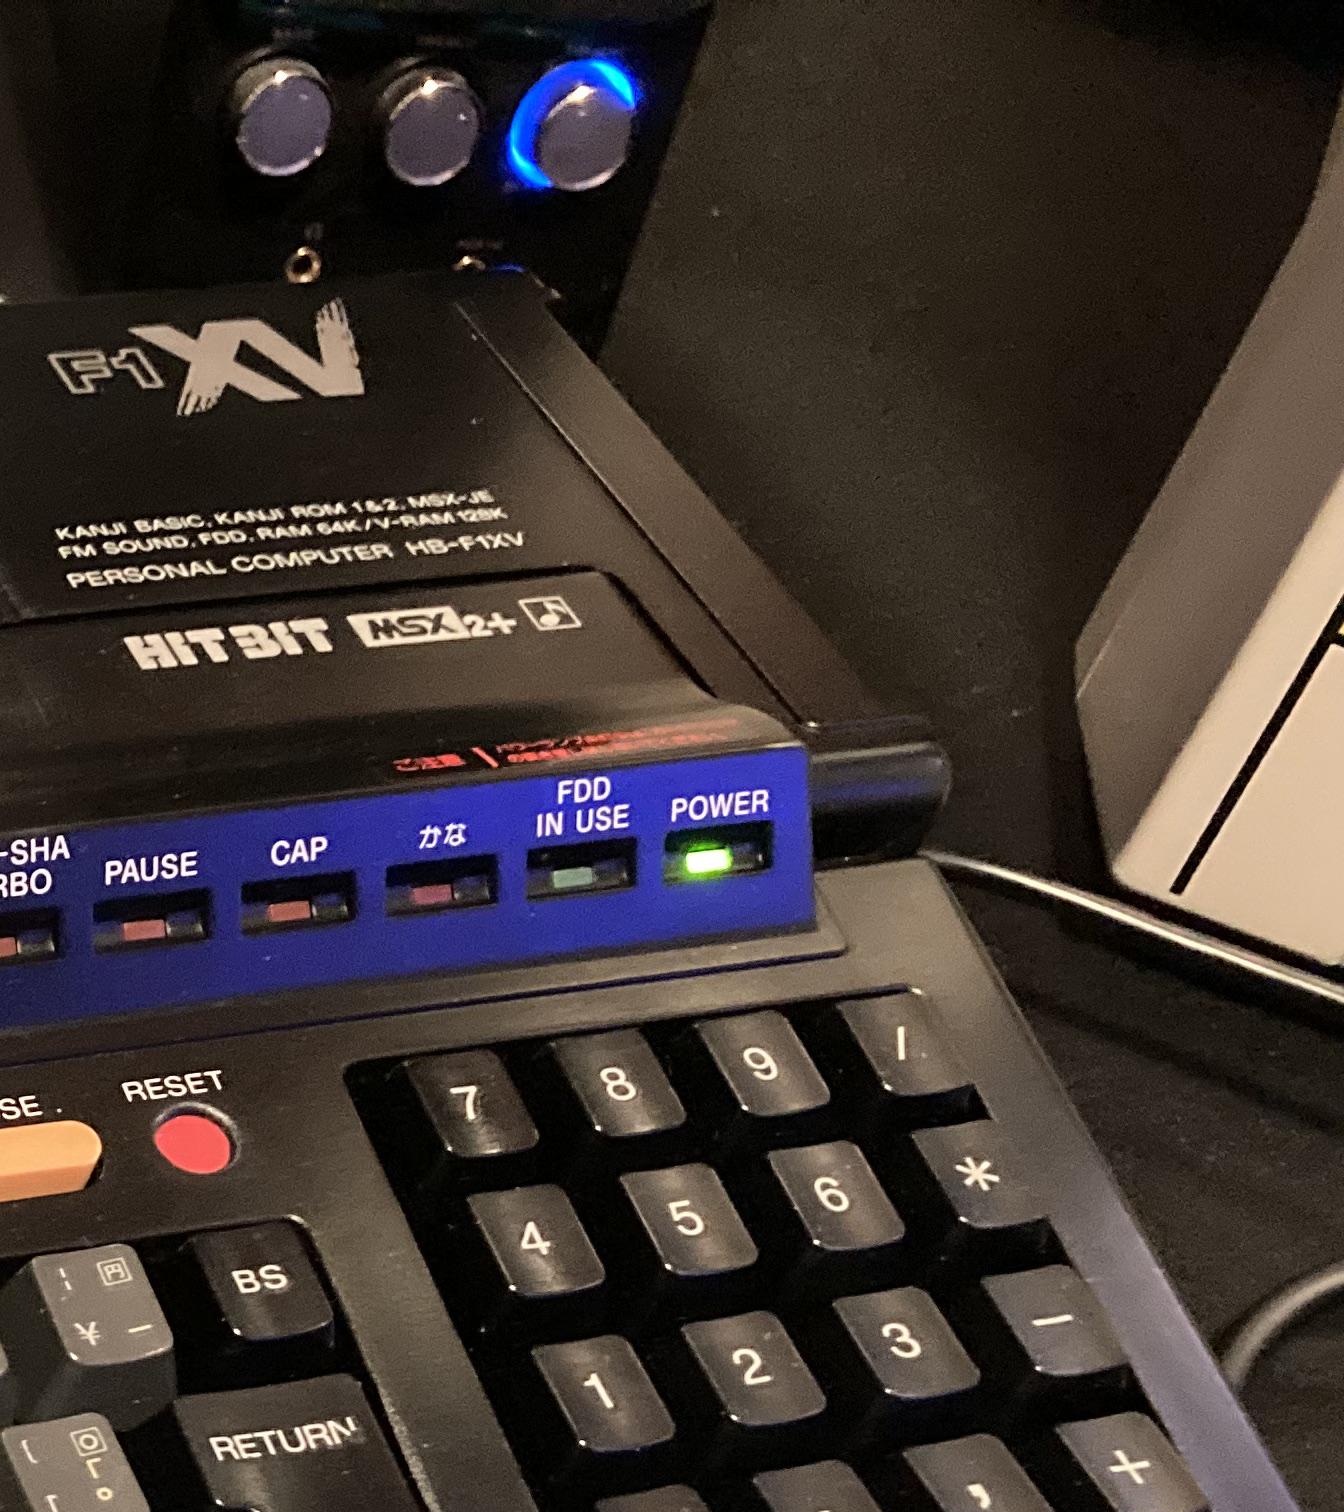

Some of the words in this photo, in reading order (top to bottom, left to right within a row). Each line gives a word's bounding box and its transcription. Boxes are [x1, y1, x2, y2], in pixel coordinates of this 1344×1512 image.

[55, 522, 127, 540] KANJI
[214, 507, 285, 526] KANJI
[291, 501, 347, 519] ROM
[58, 543, 97, 560] FM
[256, 523, 312, 541] RAM
[66, 559, 227, 589] PERSONAL
[231, 543, 394, 573] COMPUTER
[405, 531, 525, 556] HB-F1XV
[557, 776, 610, 804] FDD
[669, 787, 770, 823] POWER
[417, 821, 467, 851] かな
[536, 811, 571, 836] IN
[576, 804, 630, 833] USE
[103, 852, 198, 884] PAUSE
[269, 836, 328, 867] CAP
[743, 1048, 778, 1080] 9
[120, 1070, 223, 1103] RESET
[600, 1067, 636, 1101] 8
[450, 1086, 477, 1121] 7
[814, 1177, 849, 1211] 6
[668, 1200, 704, 1235] 5
[521, 1222, 551, 1255] 4
[232, 1266, 287, 1294] BS
[882, 1323, 921, 1358] 3
[732, 1349, 772, 1385] 2
[584, 1373, 613, 1408] 1
[210, 1416, 358, 1461] RETURN
